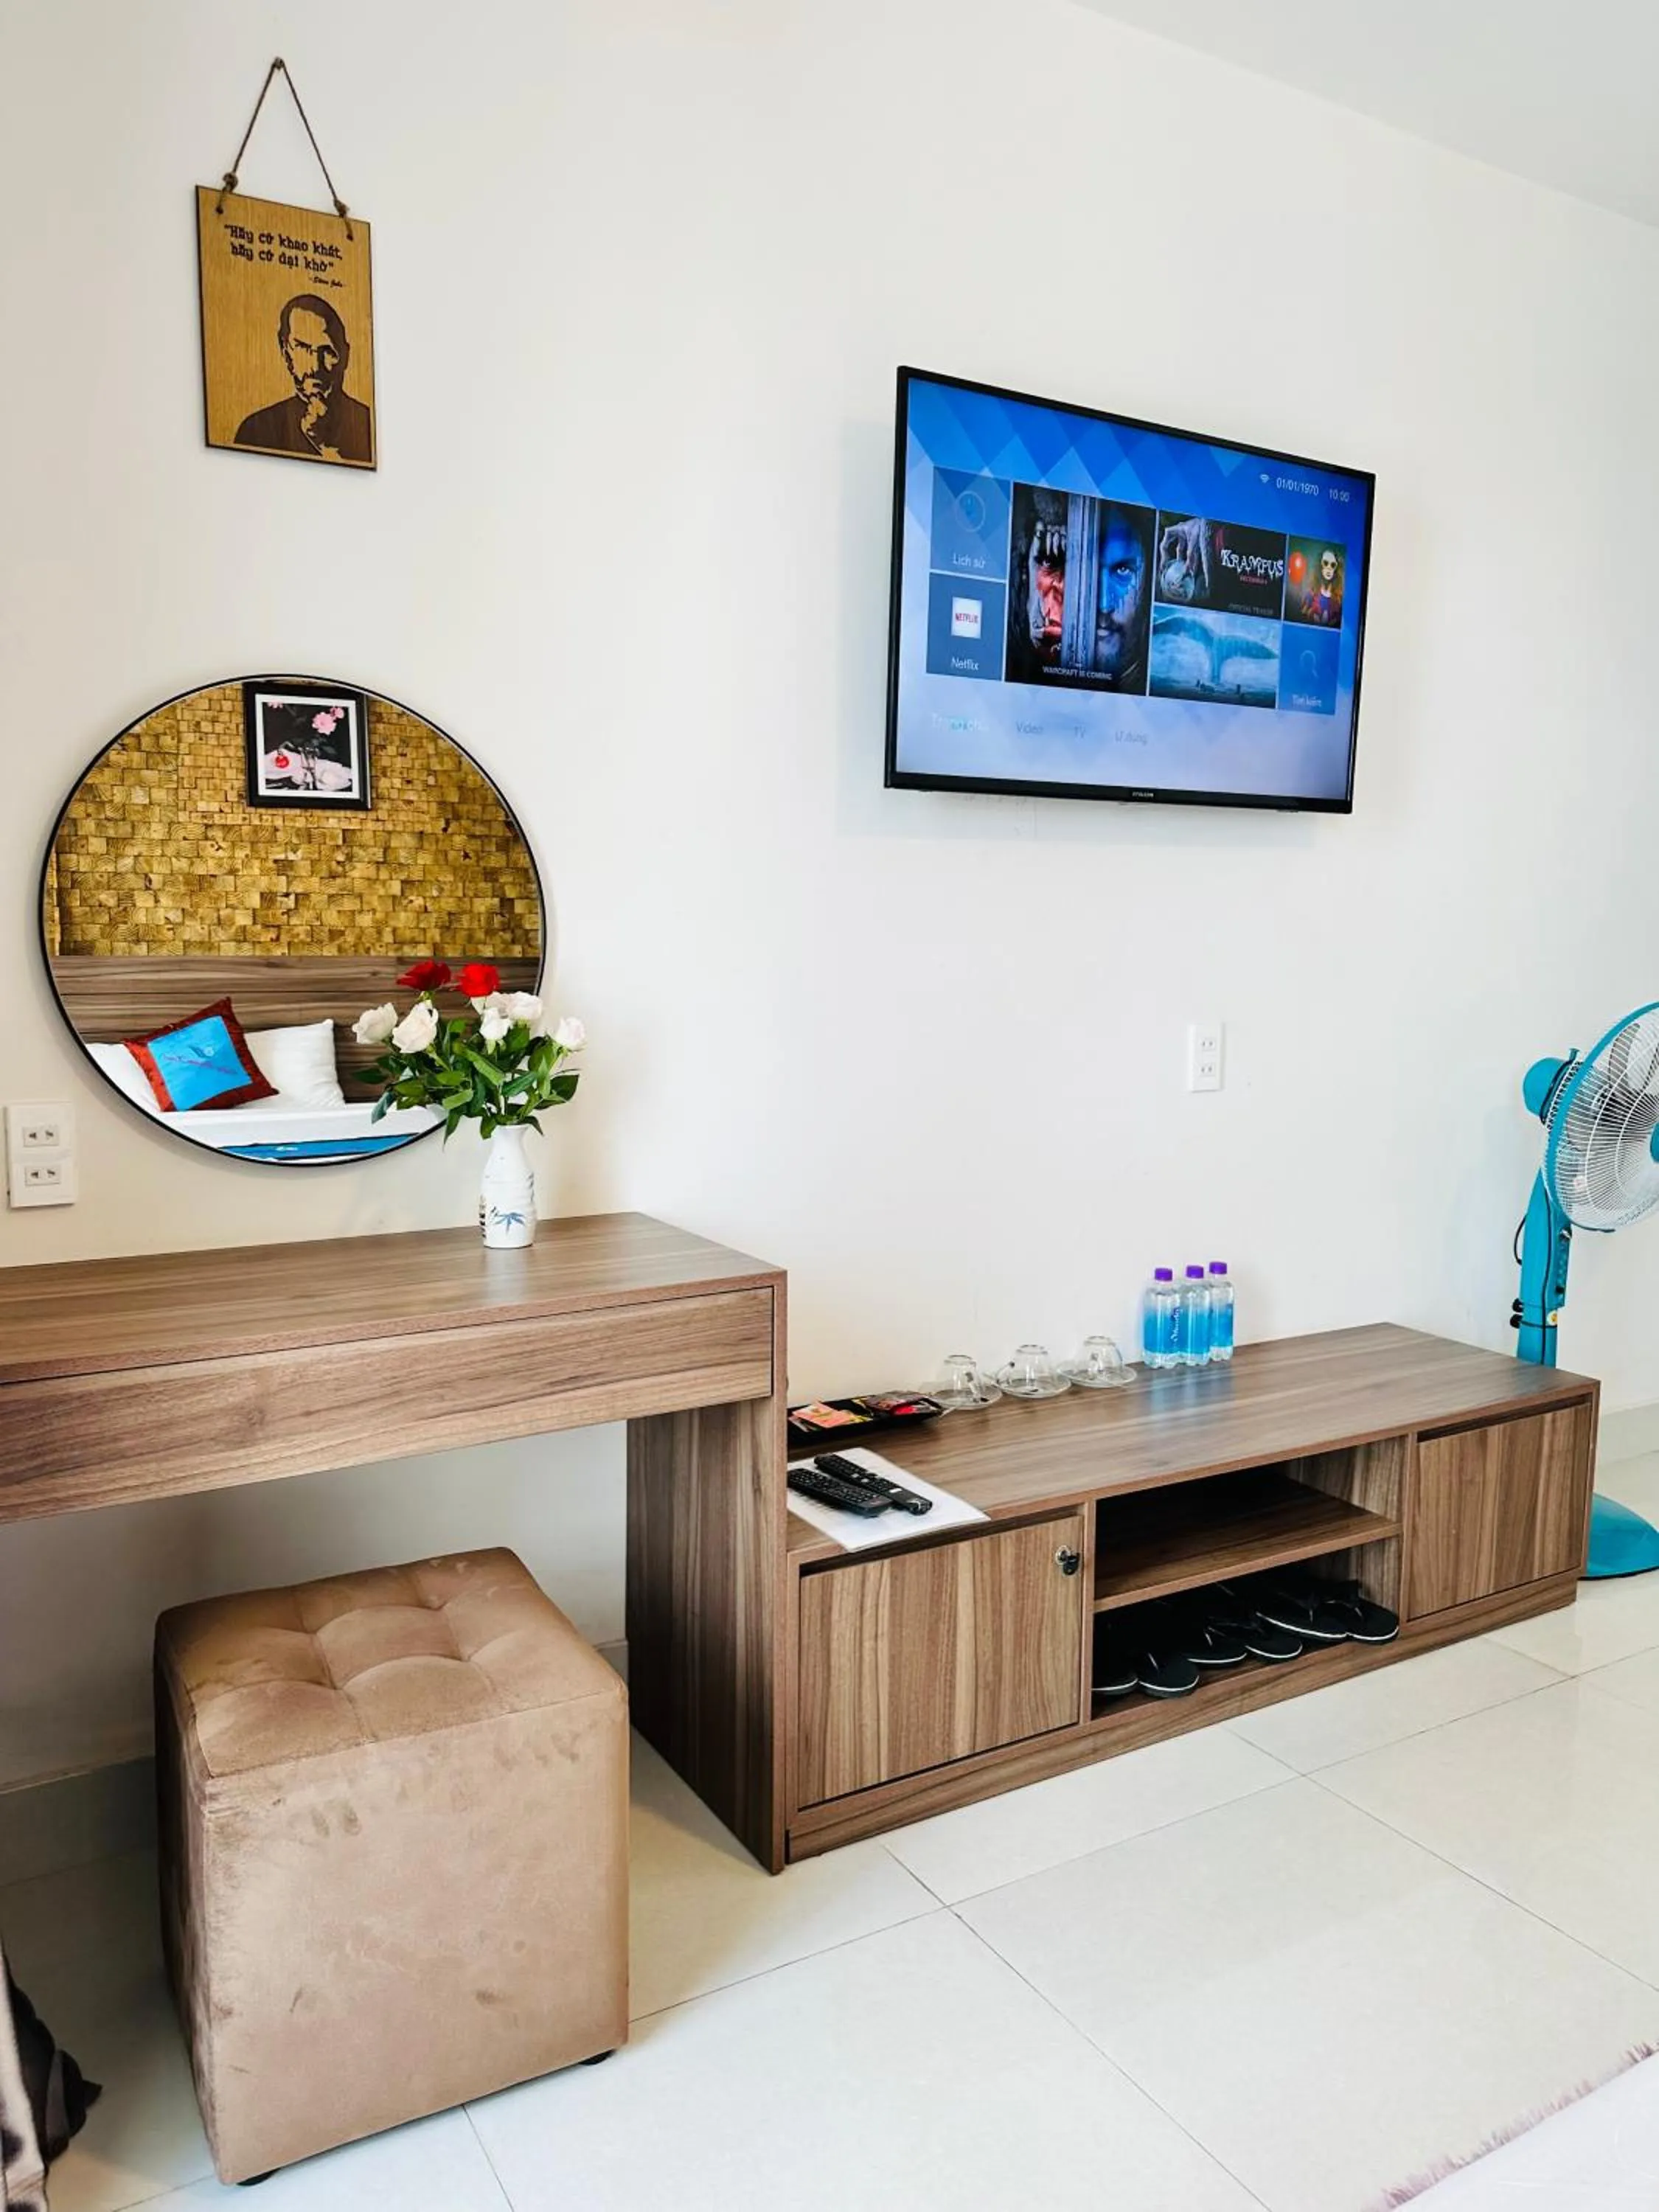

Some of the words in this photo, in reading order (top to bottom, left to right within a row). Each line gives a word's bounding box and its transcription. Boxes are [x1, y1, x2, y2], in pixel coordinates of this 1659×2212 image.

[278, 234, 308, 251] khao
[1276, 477, 1319, 496] 01/01/1970
[1220, 549, 1284, 580] KRAMPUS
[950, 656, 980, 671] Netflix
